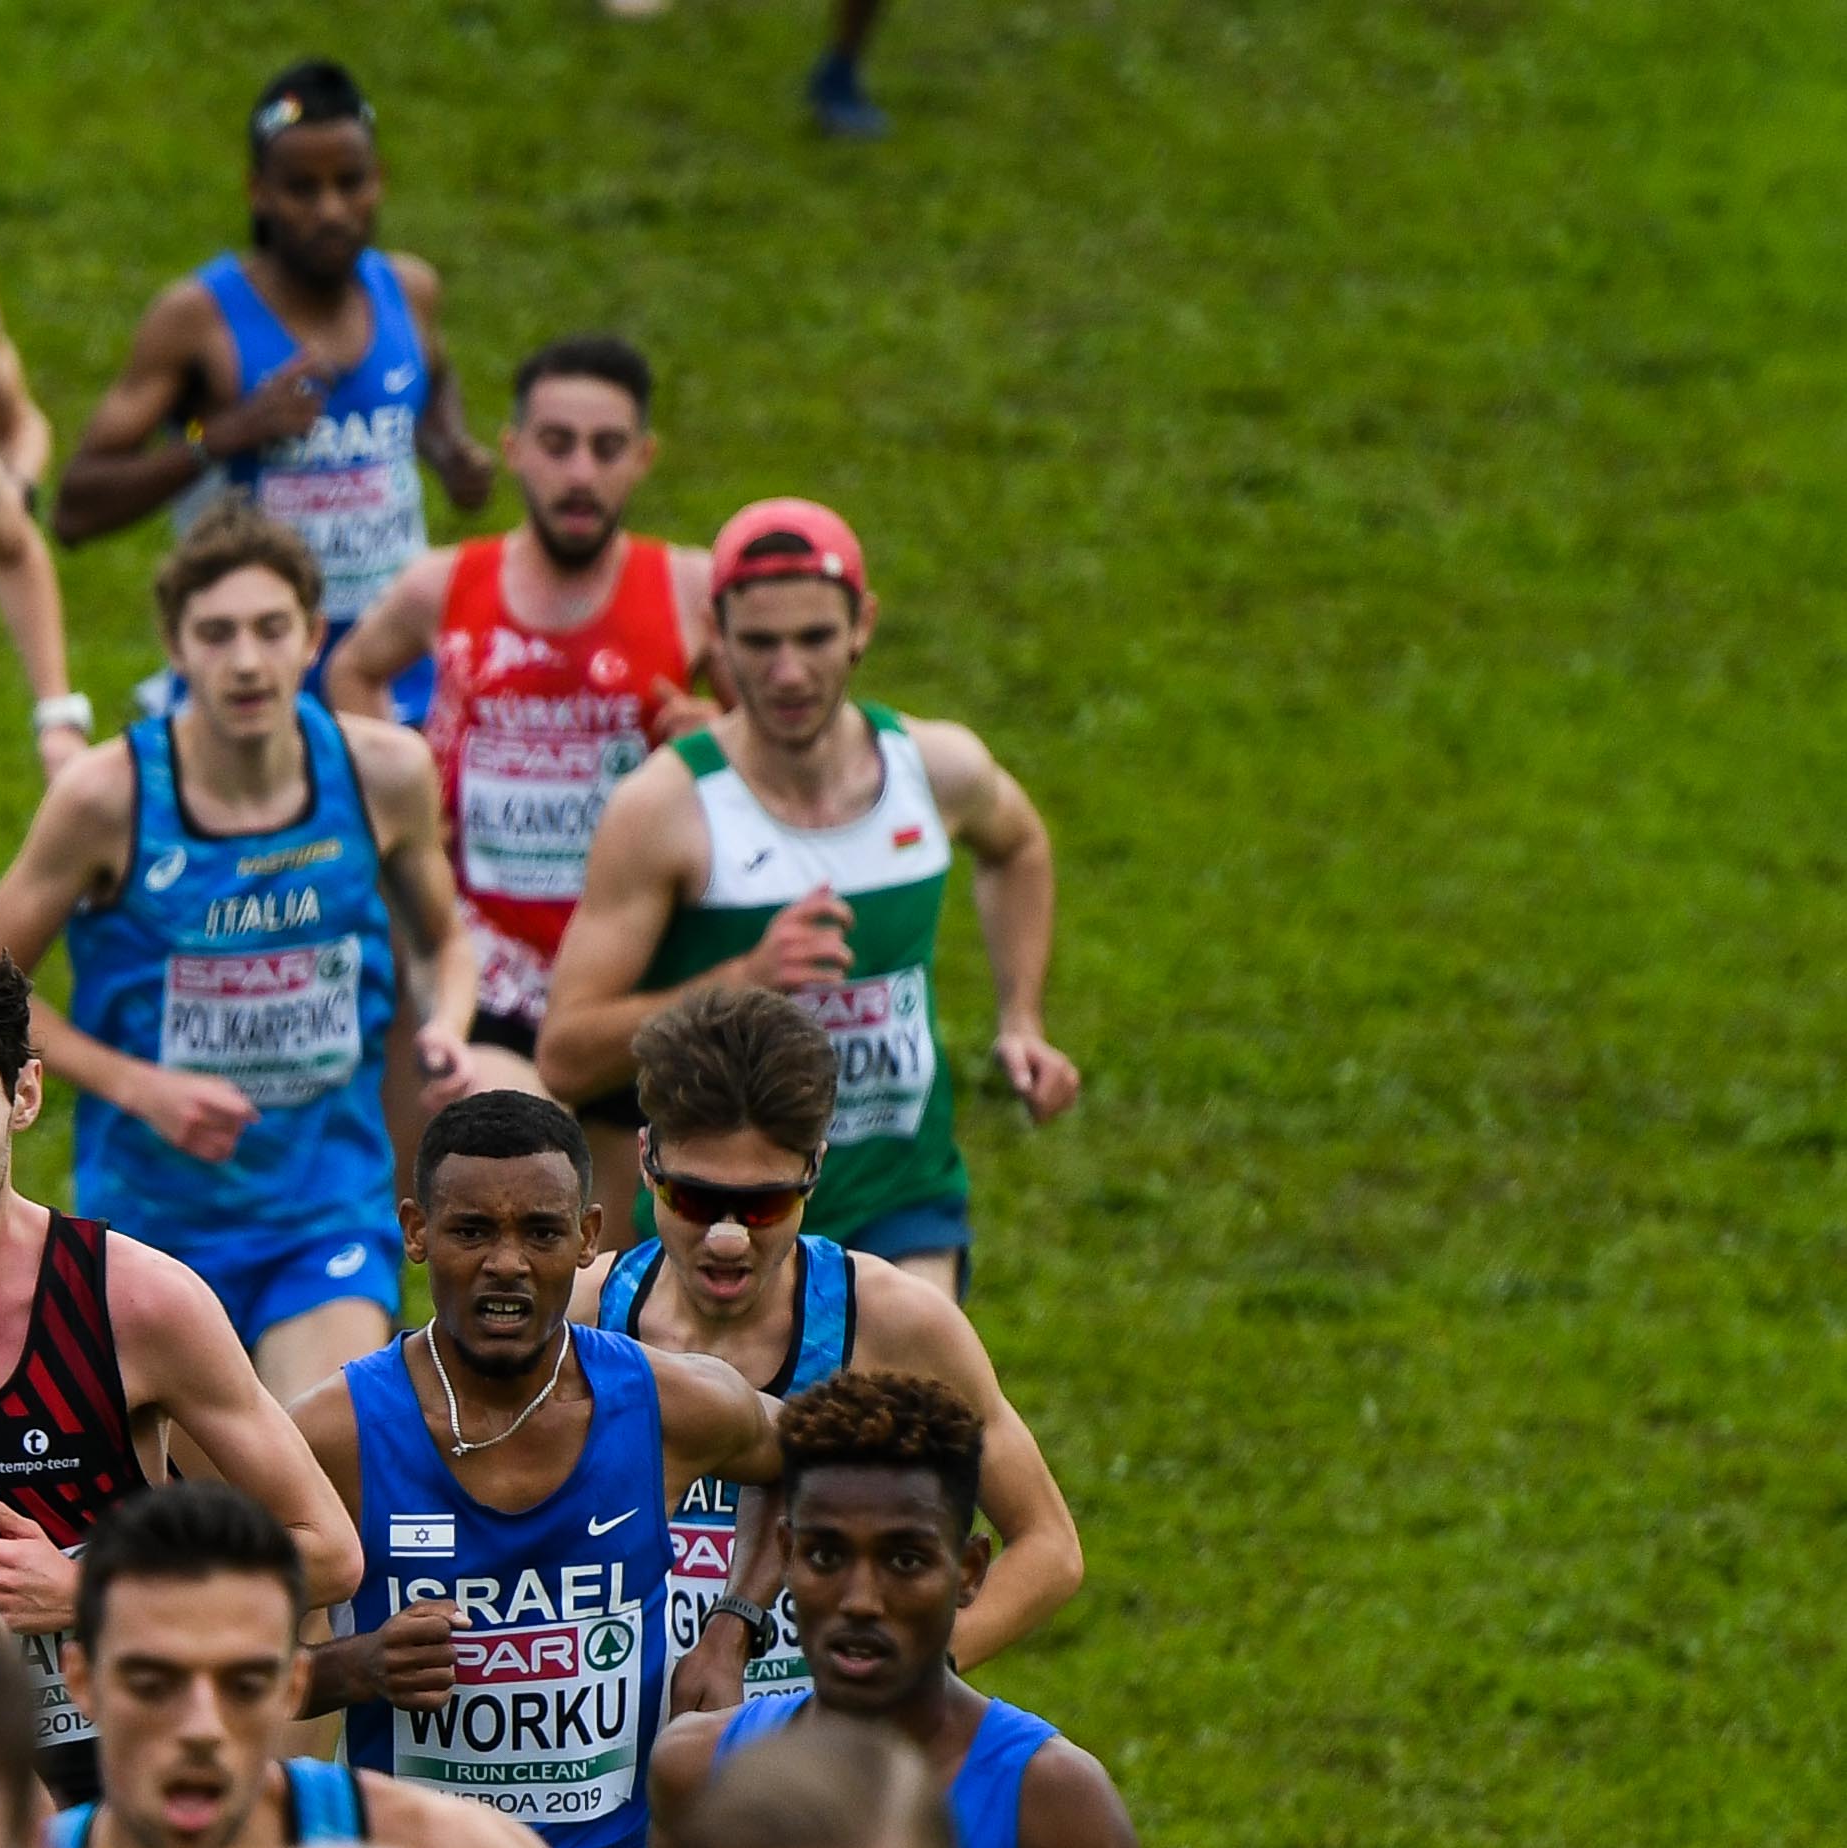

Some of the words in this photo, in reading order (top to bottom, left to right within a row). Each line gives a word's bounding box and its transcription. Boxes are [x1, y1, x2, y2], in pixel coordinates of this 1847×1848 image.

[205, 886, 321, 938] ITALIA
[408, 1677, 628, 1753] WORKU
[444, 1763, 451, 1780] I
[456, 1764, 506, 1782] RUN
[545, 1787, 603, 1813] 2019
